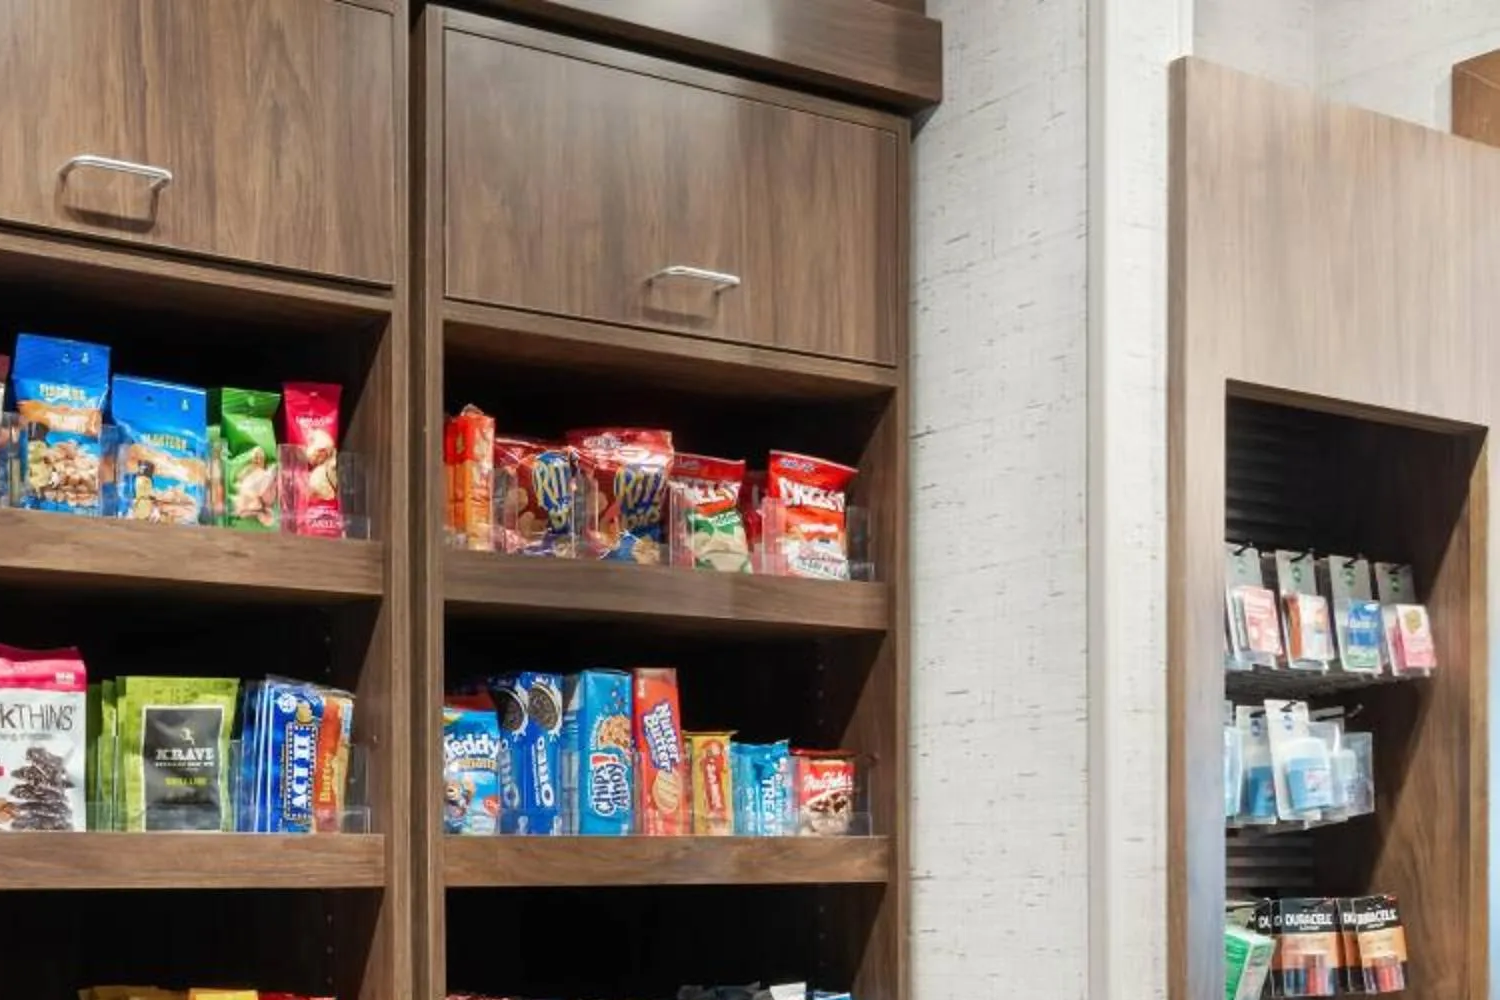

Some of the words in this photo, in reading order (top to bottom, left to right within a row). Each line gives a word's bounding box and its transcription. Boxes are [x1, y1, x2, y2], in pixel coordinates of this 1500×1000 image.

[155, 747, 214, 761] KRAVE
[643, 713, 672, 773] Butter
[656, 703, 680, 764] Nutter
[292, 766, 309, 809] ACT
[537, 736, 554, 807] OREO
[593, 762, 614, 816] Chips
[1284, 912, 1333, 926] DURACELL
[1357, 908, 1398, 925] DURACELL
